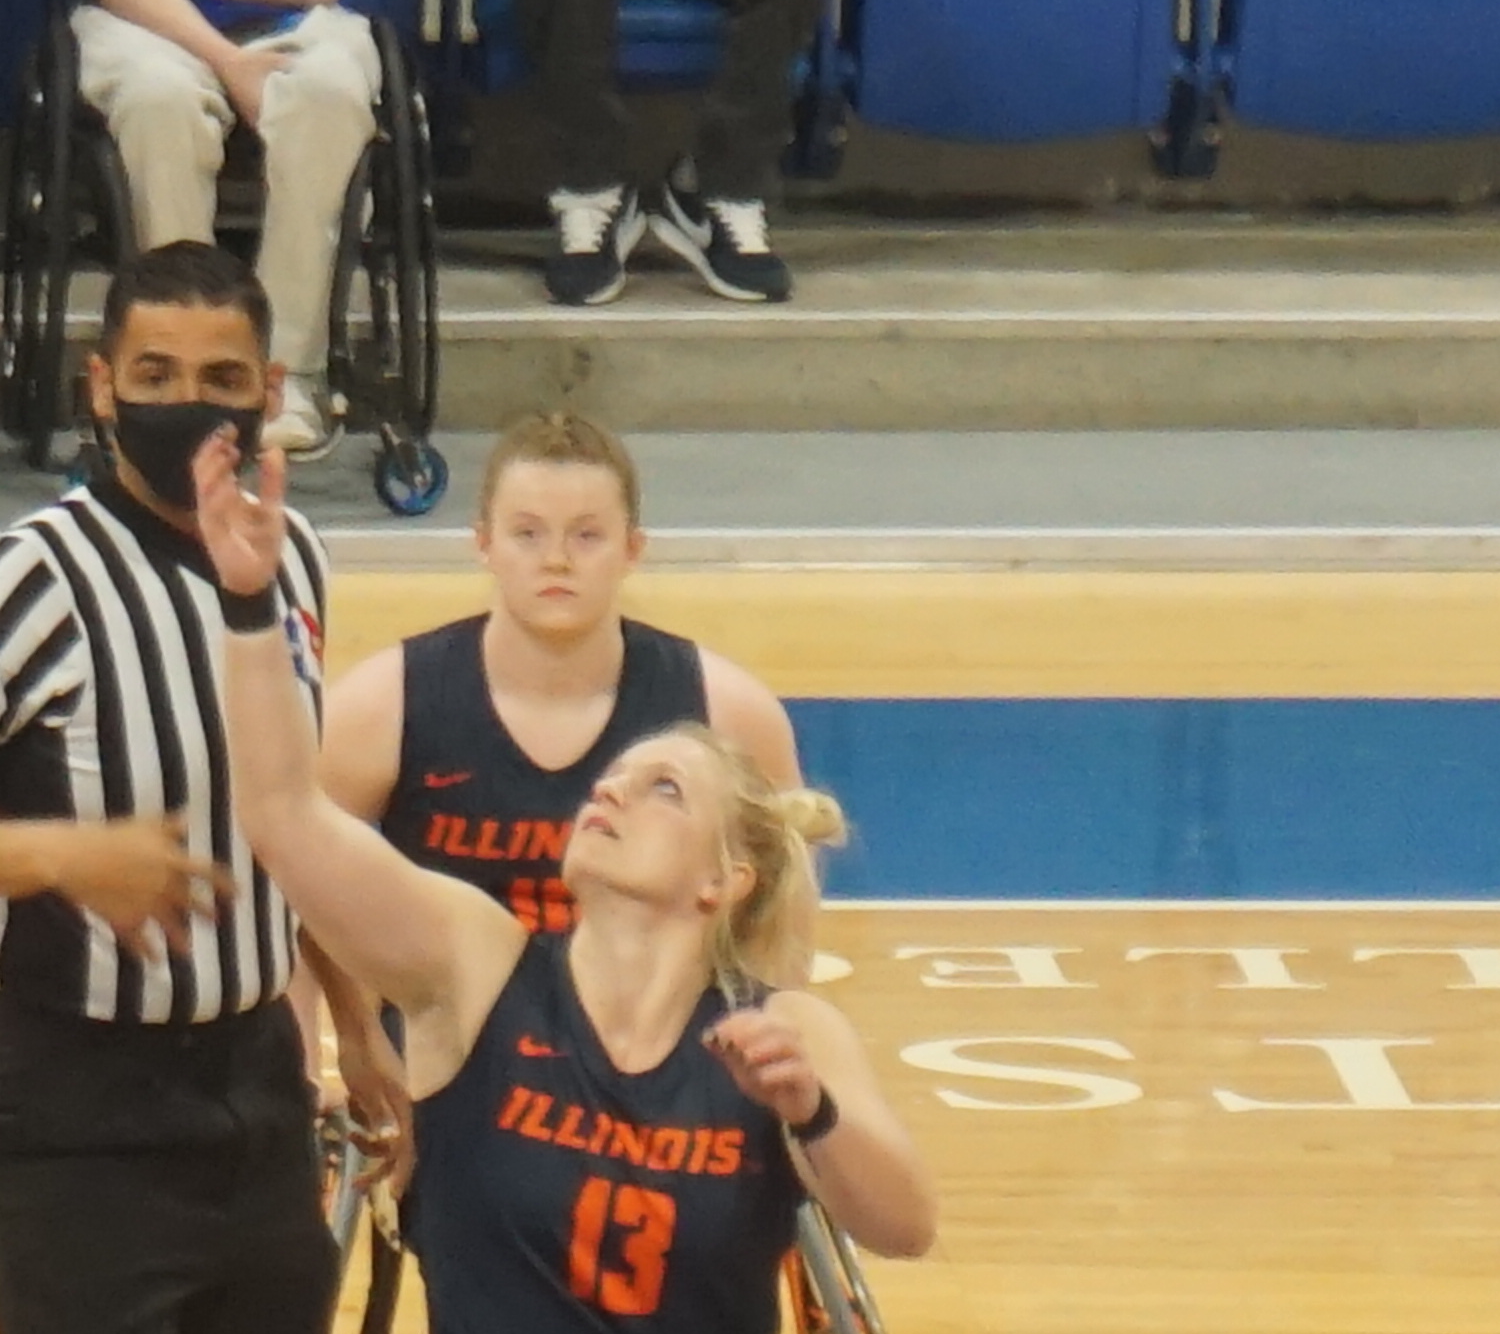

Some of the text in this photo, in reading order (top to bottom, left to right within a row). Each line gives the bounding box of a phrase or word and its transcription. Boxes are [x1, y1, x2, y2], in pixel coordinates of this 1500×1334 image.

[427, 812, 570, 861] ILLIN
[499, 1084, 746, 1176] ILLINOIS
[565, 1175, 677, 1317] 13
